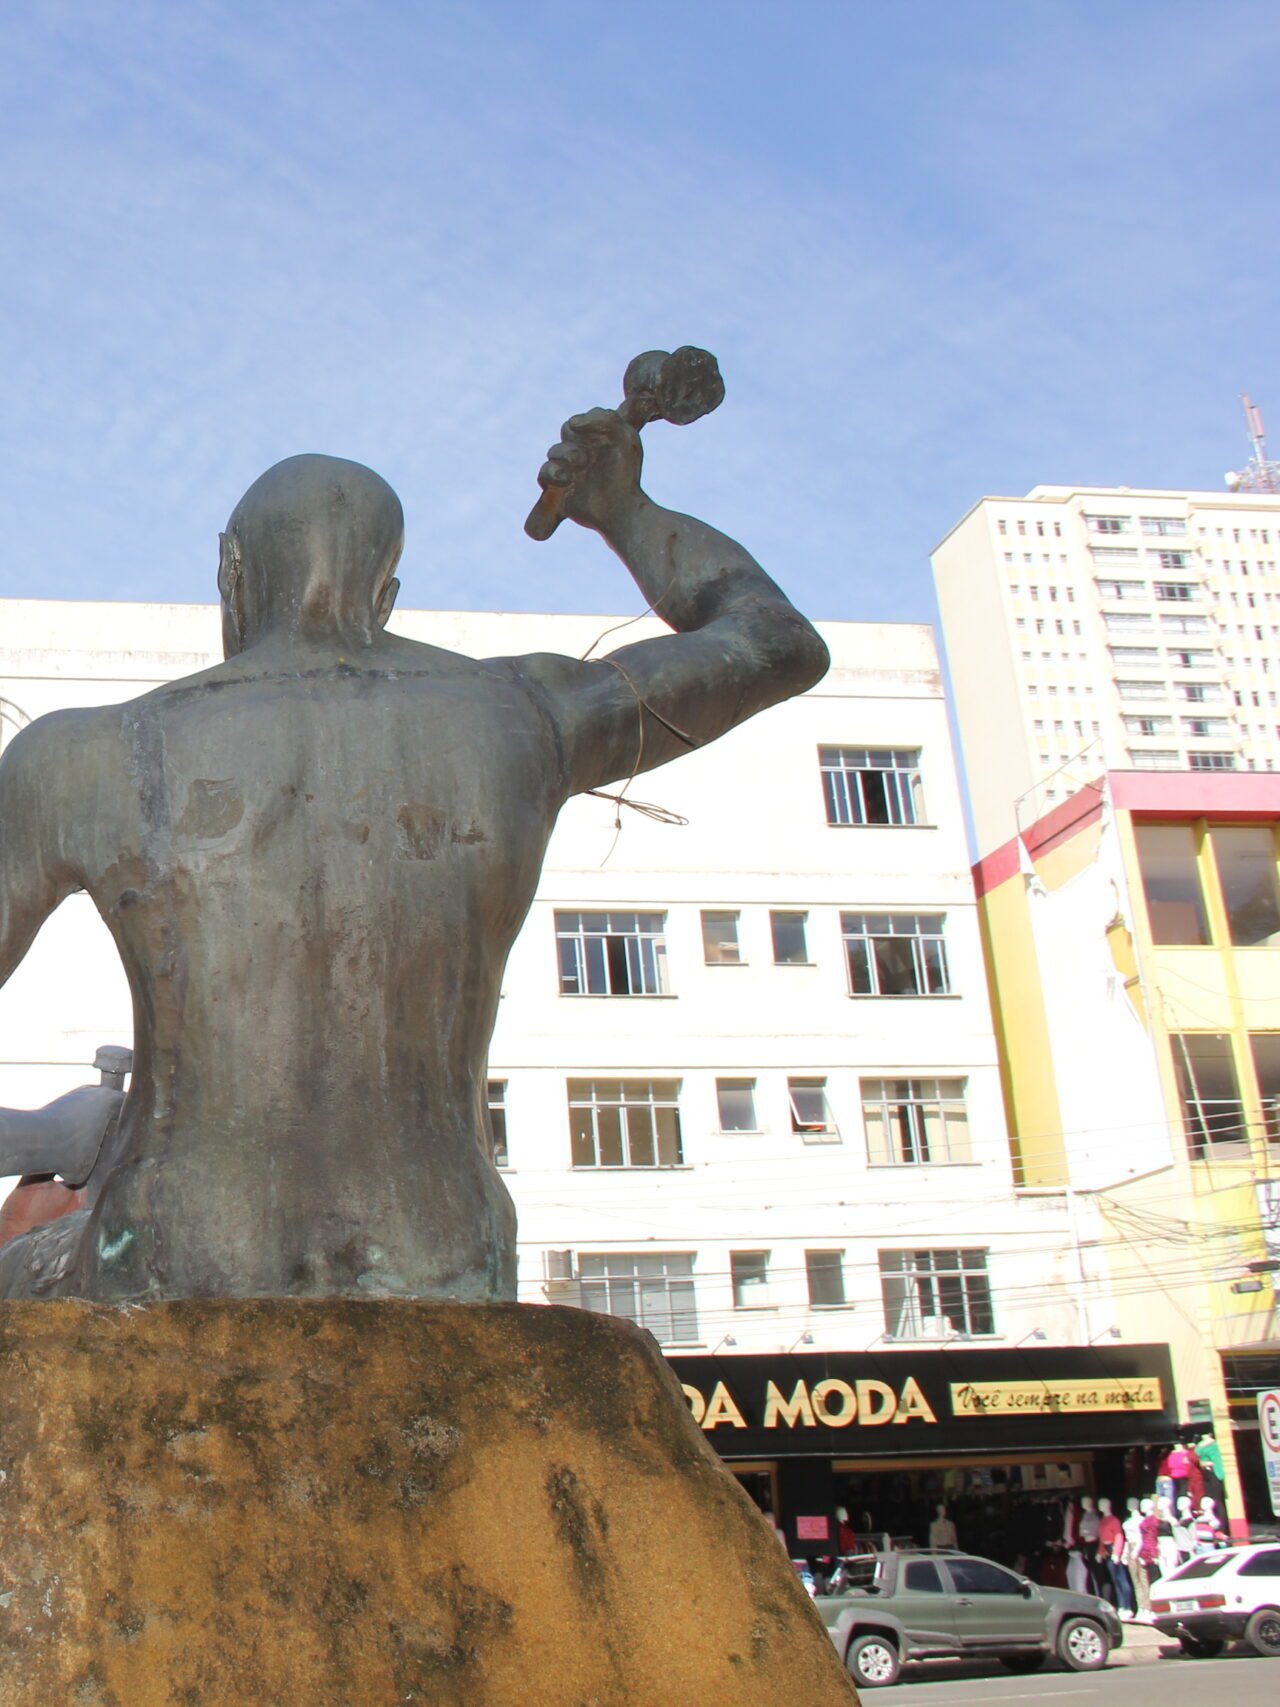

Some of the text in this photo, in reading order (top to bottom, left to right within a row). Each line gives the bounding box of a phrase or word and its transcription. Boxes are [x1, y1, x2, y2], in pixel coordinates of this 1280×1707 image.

[763, 1376, 938, 1428] MODA
[957, 1384, 1154, 1411] Você sempre na moda
